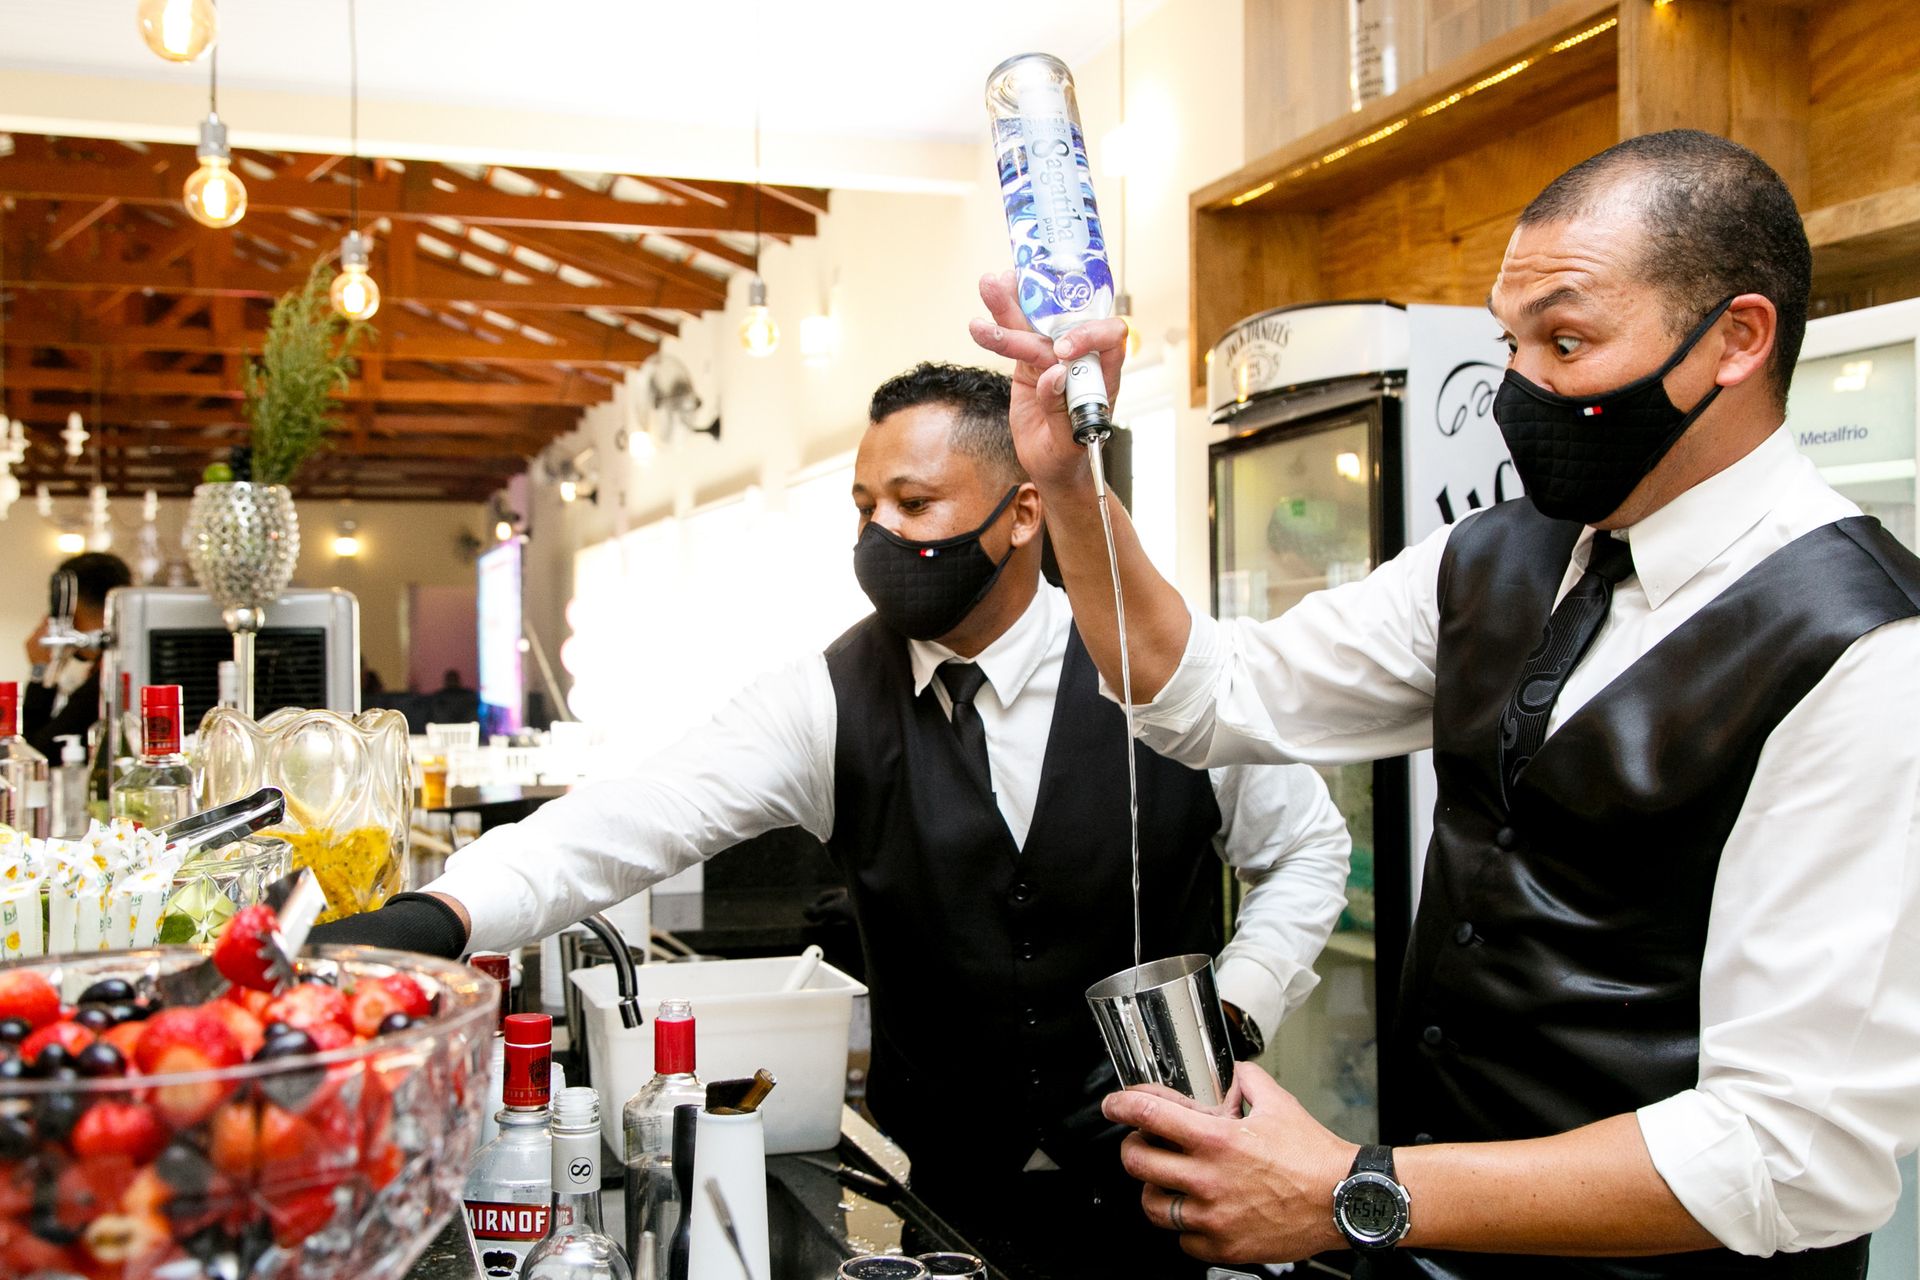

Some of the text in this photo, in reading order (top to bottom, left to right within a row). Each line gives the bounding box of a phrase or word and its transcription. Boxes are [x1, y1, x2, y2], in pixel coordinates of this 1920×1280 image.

[1031, 139, 1082, 241] Sagatiba
[1043, 216, 1056, 244] pura
[1800, 424, 1869, 447] Metalfrio
